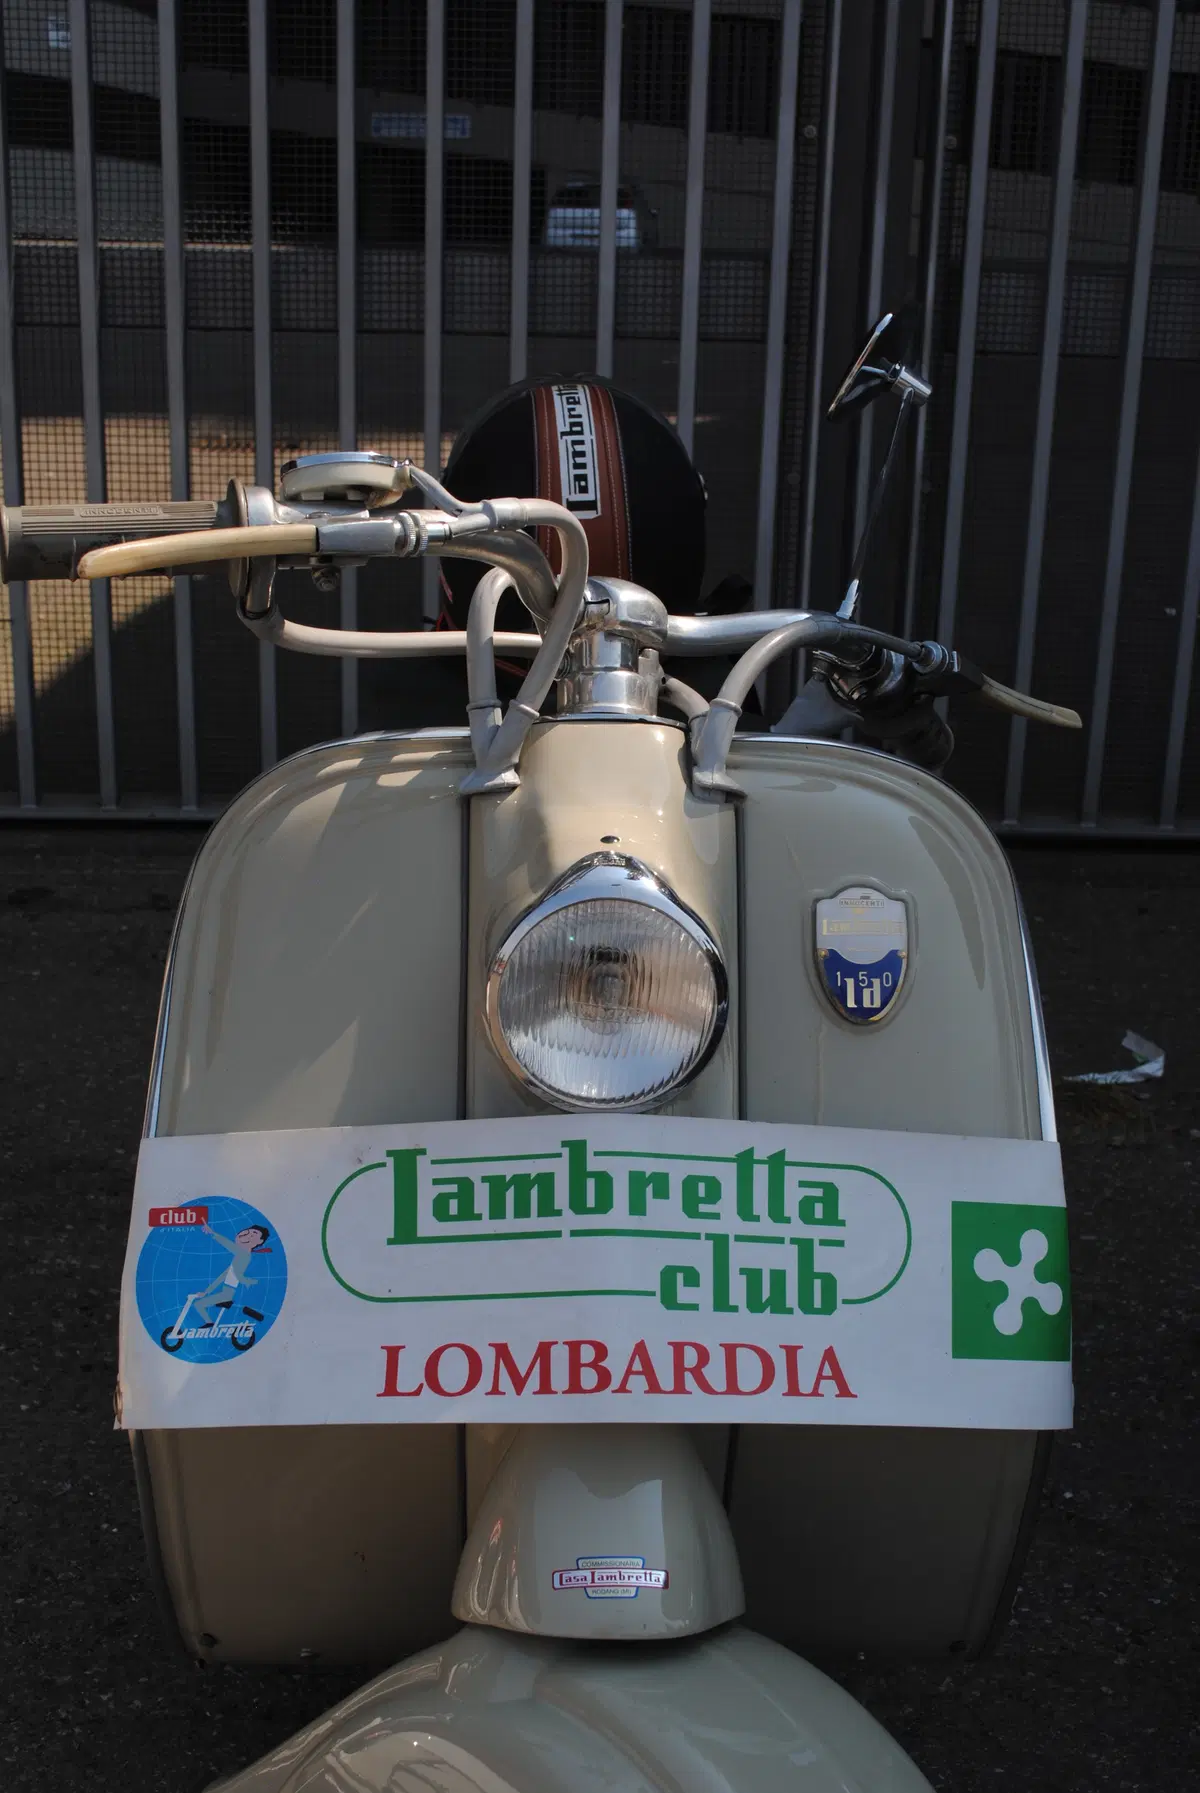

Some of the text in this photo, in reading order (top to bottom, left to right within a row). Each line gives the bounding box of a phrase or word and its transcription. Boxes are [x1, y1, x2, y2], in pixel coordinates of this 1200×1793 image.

[386, 1139, 846, 1245] Lambretta
[160, 1208, 197, 1225] club
[659, 1232, 838, 1316] club
[167, 1319, 256, 1340] Lambretta
[376, 1339, 858, 1399] LOMBARDIA
[589, 1570, 661, 1584] Lambretta
